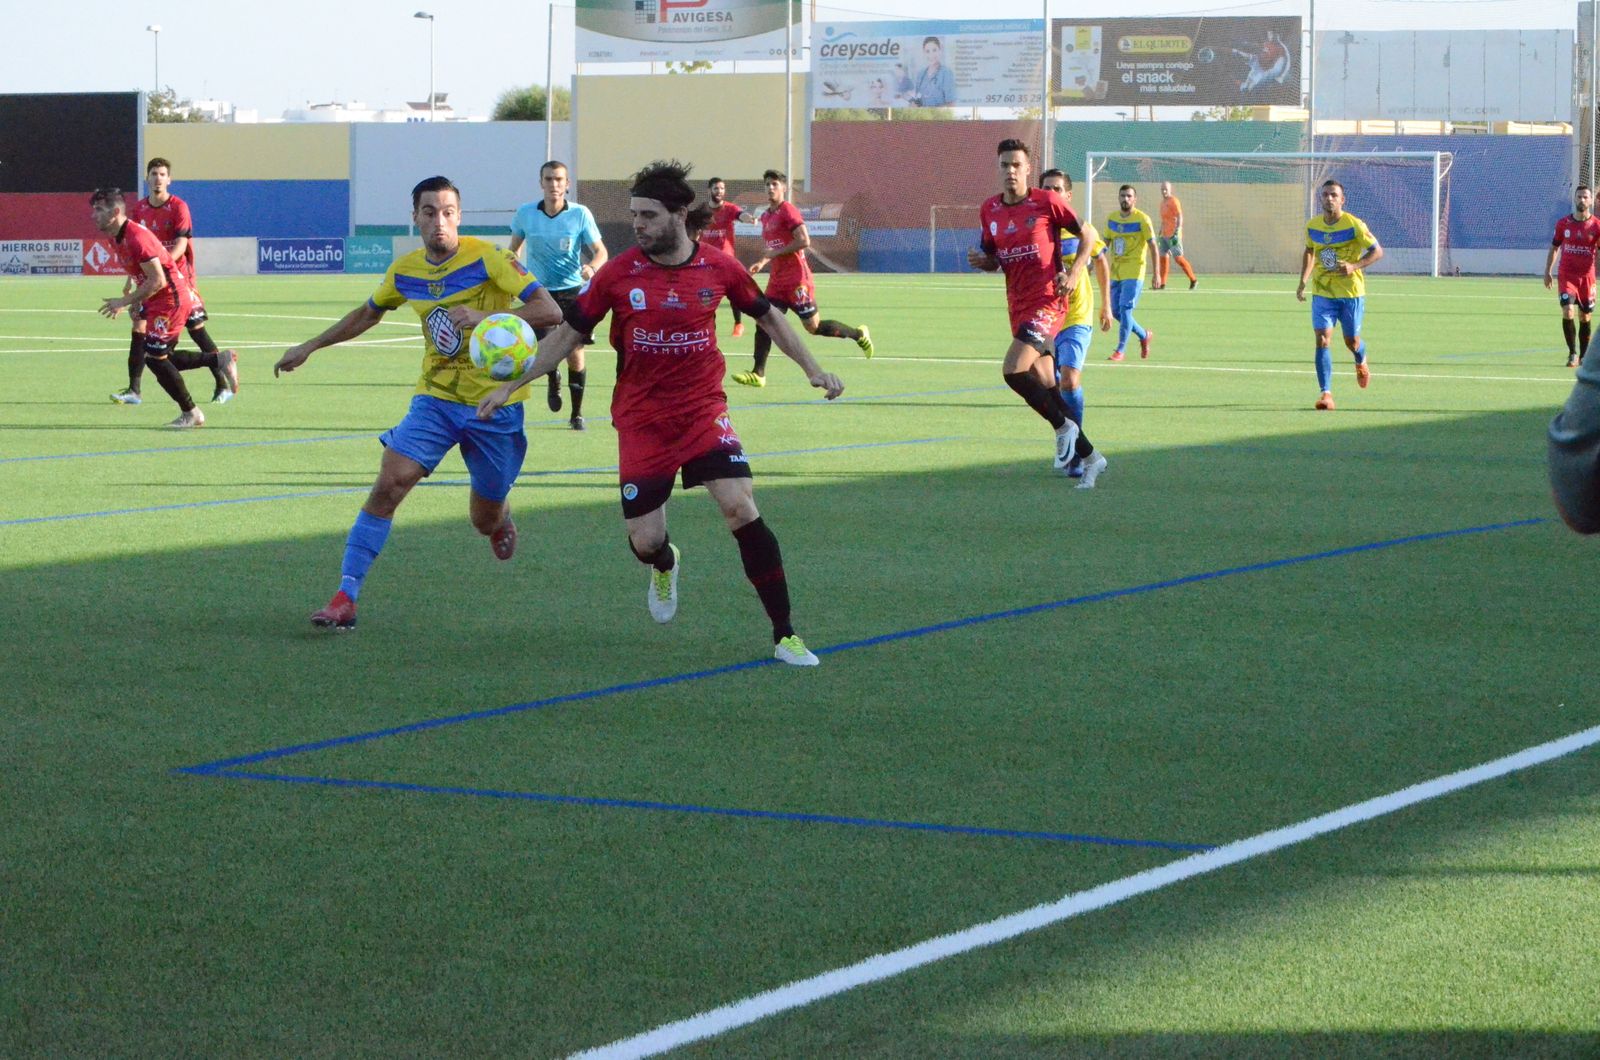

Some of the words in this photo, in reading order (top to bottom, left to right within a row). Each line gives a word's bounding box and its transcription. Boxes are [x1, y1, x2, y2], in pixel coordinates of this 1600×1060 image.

[673, 11, 733, 23] AVIGESA
[820, 38, 900, 60] creysade
[1121, 70, 1133, 83] el
[1136, 70, 1175, 83] snack
[985, 94, 1002, 103] 957
[1003, 94, 1016, 103] 60
[1017, 94, 1029, 103] 35
[1, 243, 50, 252] HIERROS
[54, 242, 80, 251] RUIZ
[260, 245, 343, 262] Merkabaño
